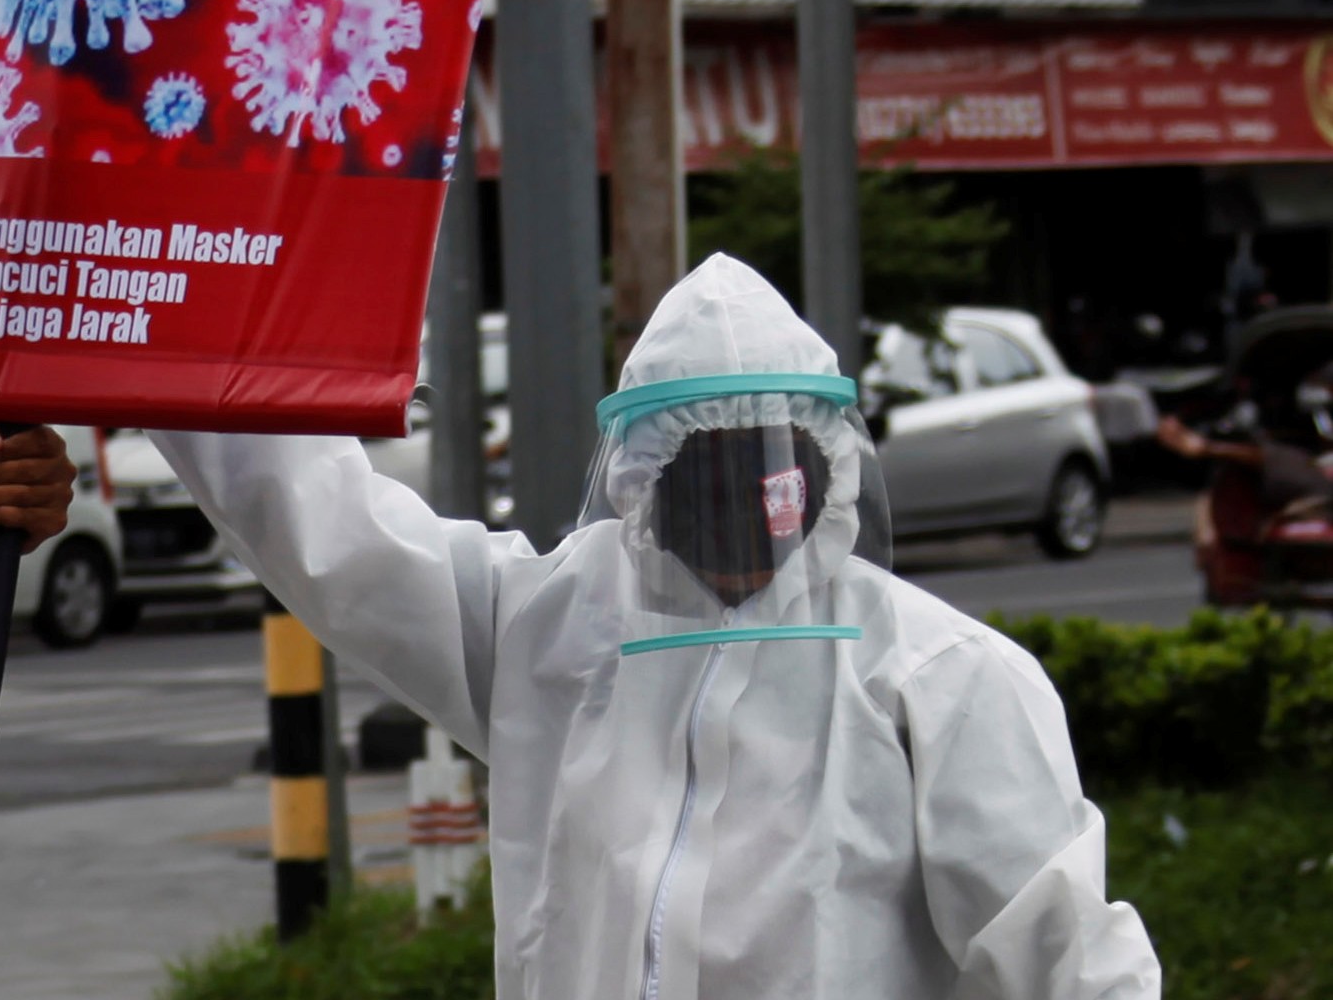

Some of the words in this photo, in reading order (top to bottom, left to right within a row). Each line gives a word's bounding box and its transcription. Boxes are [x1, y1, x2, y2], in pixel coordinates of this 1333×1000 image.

[167, 225, 282, 266] Masker
[76, 266, 187, 307] Tangan
[68, 306, 151, 344] Jarak
